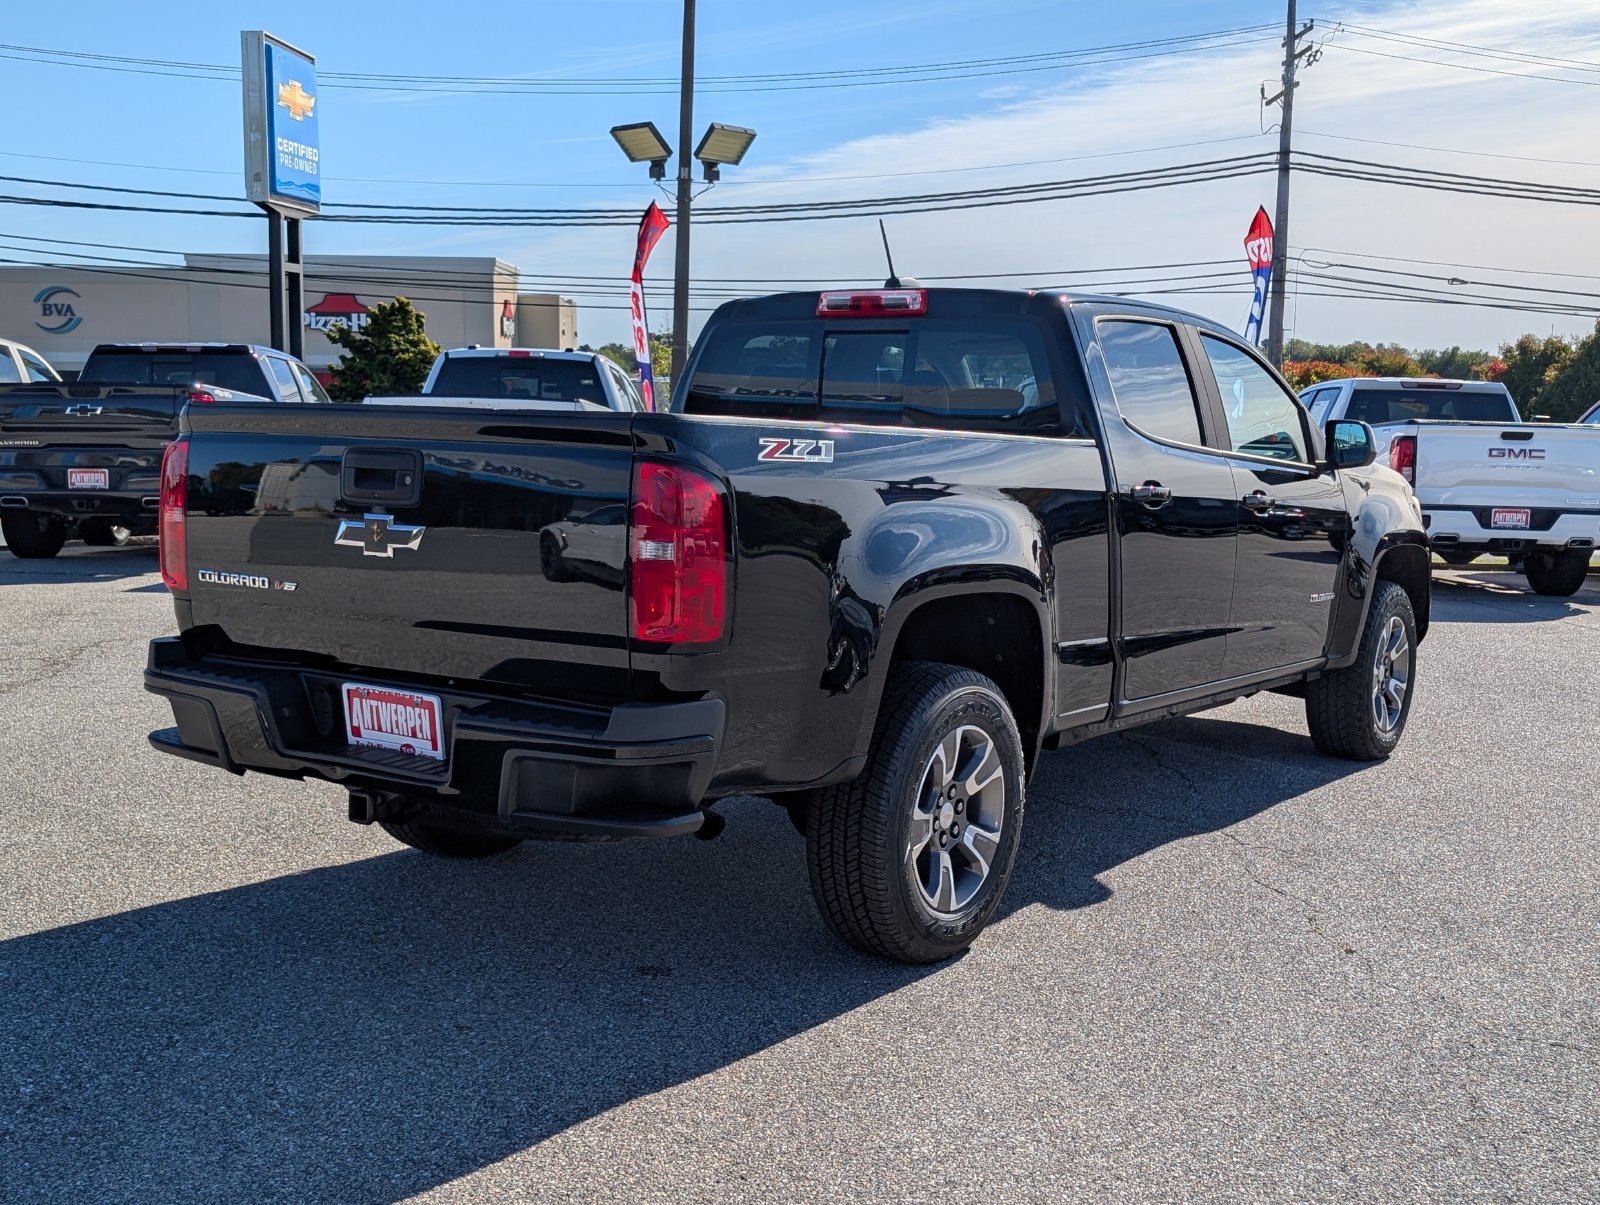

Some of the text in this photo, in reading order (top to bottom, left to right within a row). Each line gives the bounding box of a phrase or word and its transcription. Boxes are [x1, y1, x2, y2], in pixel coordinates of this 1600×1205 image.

[277, 137, 319, 162] CERTIFIED
[280, 153, 318, 175] PRE-OWNED
[41, 303, 76, 317] BVA
[758, 437, 835, 462] Z71
[1488, 447, 1546, 460] GMC
[71, 472, 105, 484] ANTWERPEN
[1494, 512, 1527, 523] ANTWERPEN
[198, 569, 298, 592] COLORADO V6
[352, 696, 432, 741] ANTWERPEN
